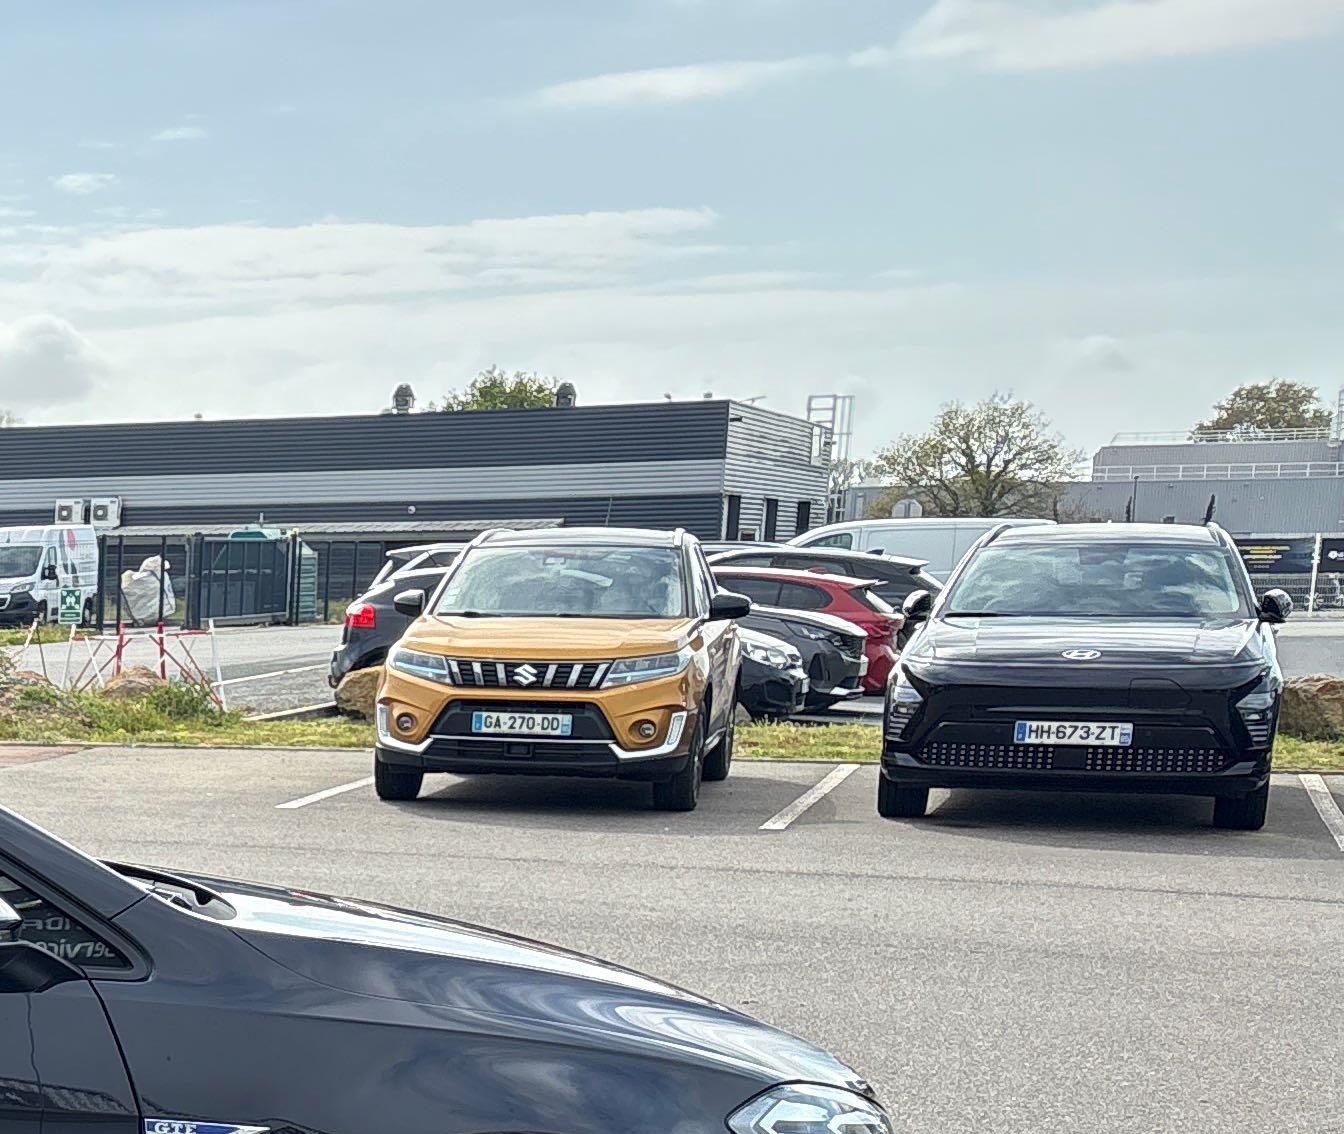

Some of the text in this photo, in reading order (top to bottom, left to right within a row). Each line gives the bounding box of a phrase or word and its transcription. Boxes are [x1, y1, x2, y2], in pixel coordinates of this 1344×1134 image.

[484, 715, 559, 730] GA-270-DD
[1028, 724, 1119, 740] HH-673-ZT
[154, 1122, 197, 1134] GTE
